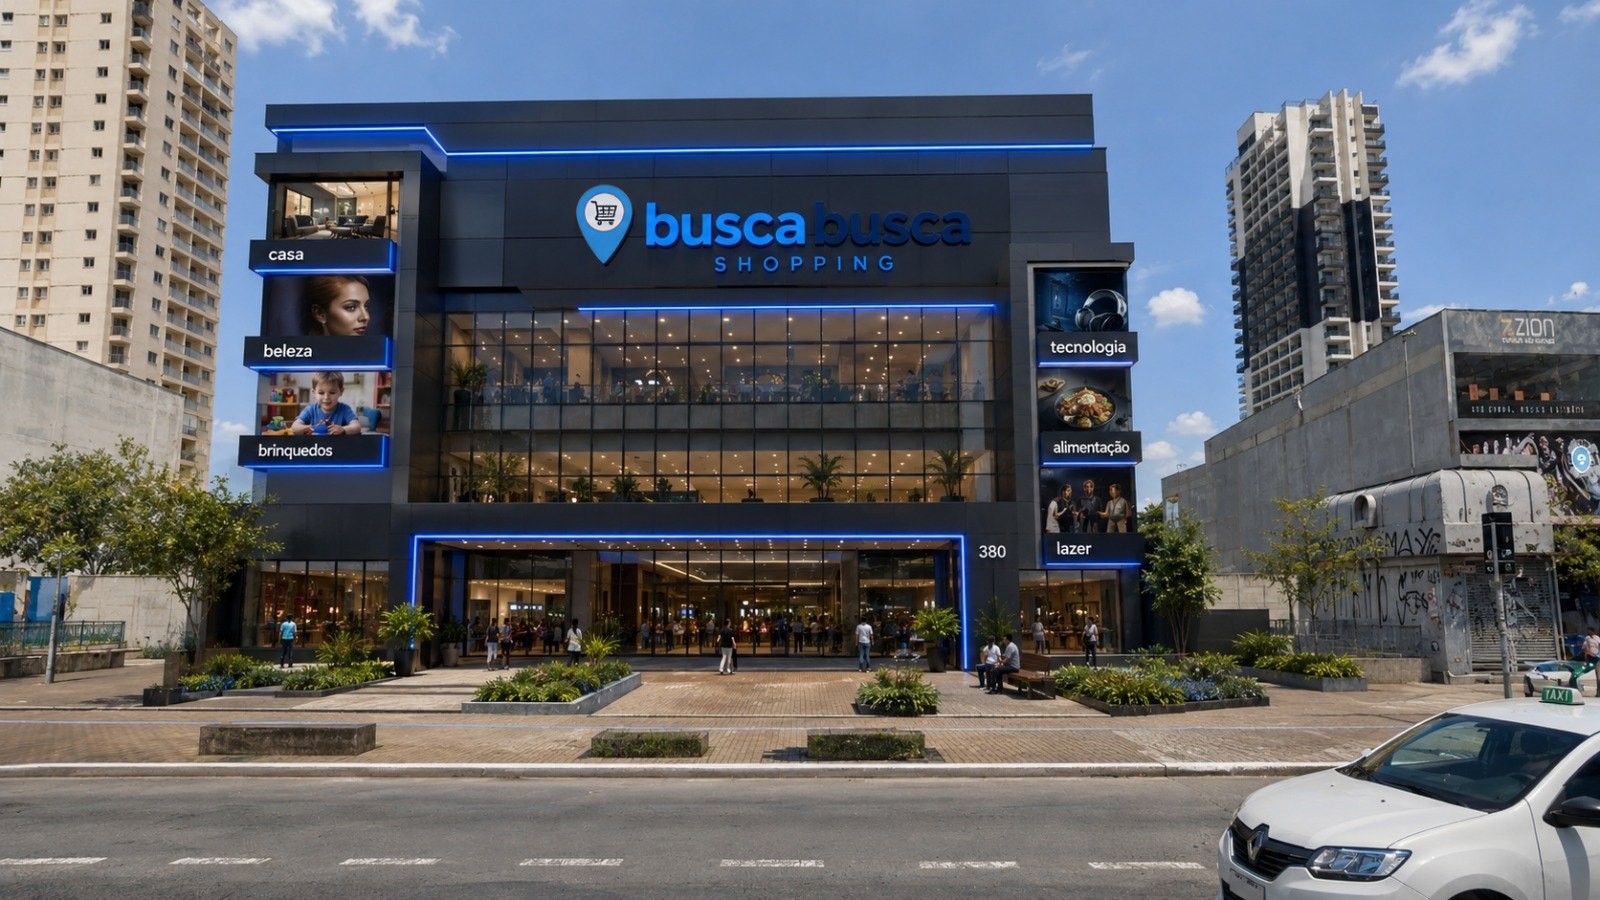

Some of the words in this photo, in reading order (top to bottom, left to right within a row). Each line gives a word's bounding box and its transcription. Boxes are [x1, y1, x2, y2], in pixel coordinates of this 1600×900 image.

[645, 201, 806, 248] busca
[814, 202, 972, 246] busca
[268, 249, 304, 261] casa
[714, 254, 895, 273] SHOPPING
[263, 343, 313, 358] beleza
[1050, 339, 1127, 357] tecnologia
[258, 443, 333, 460] brinquedos
[1053, 440, 1130, 457] alimentação
[978, 544, 1007, 559] 380
[1056, 541, 1092, 556] lazer
[1545, 689, 1569, 702] TAXI
